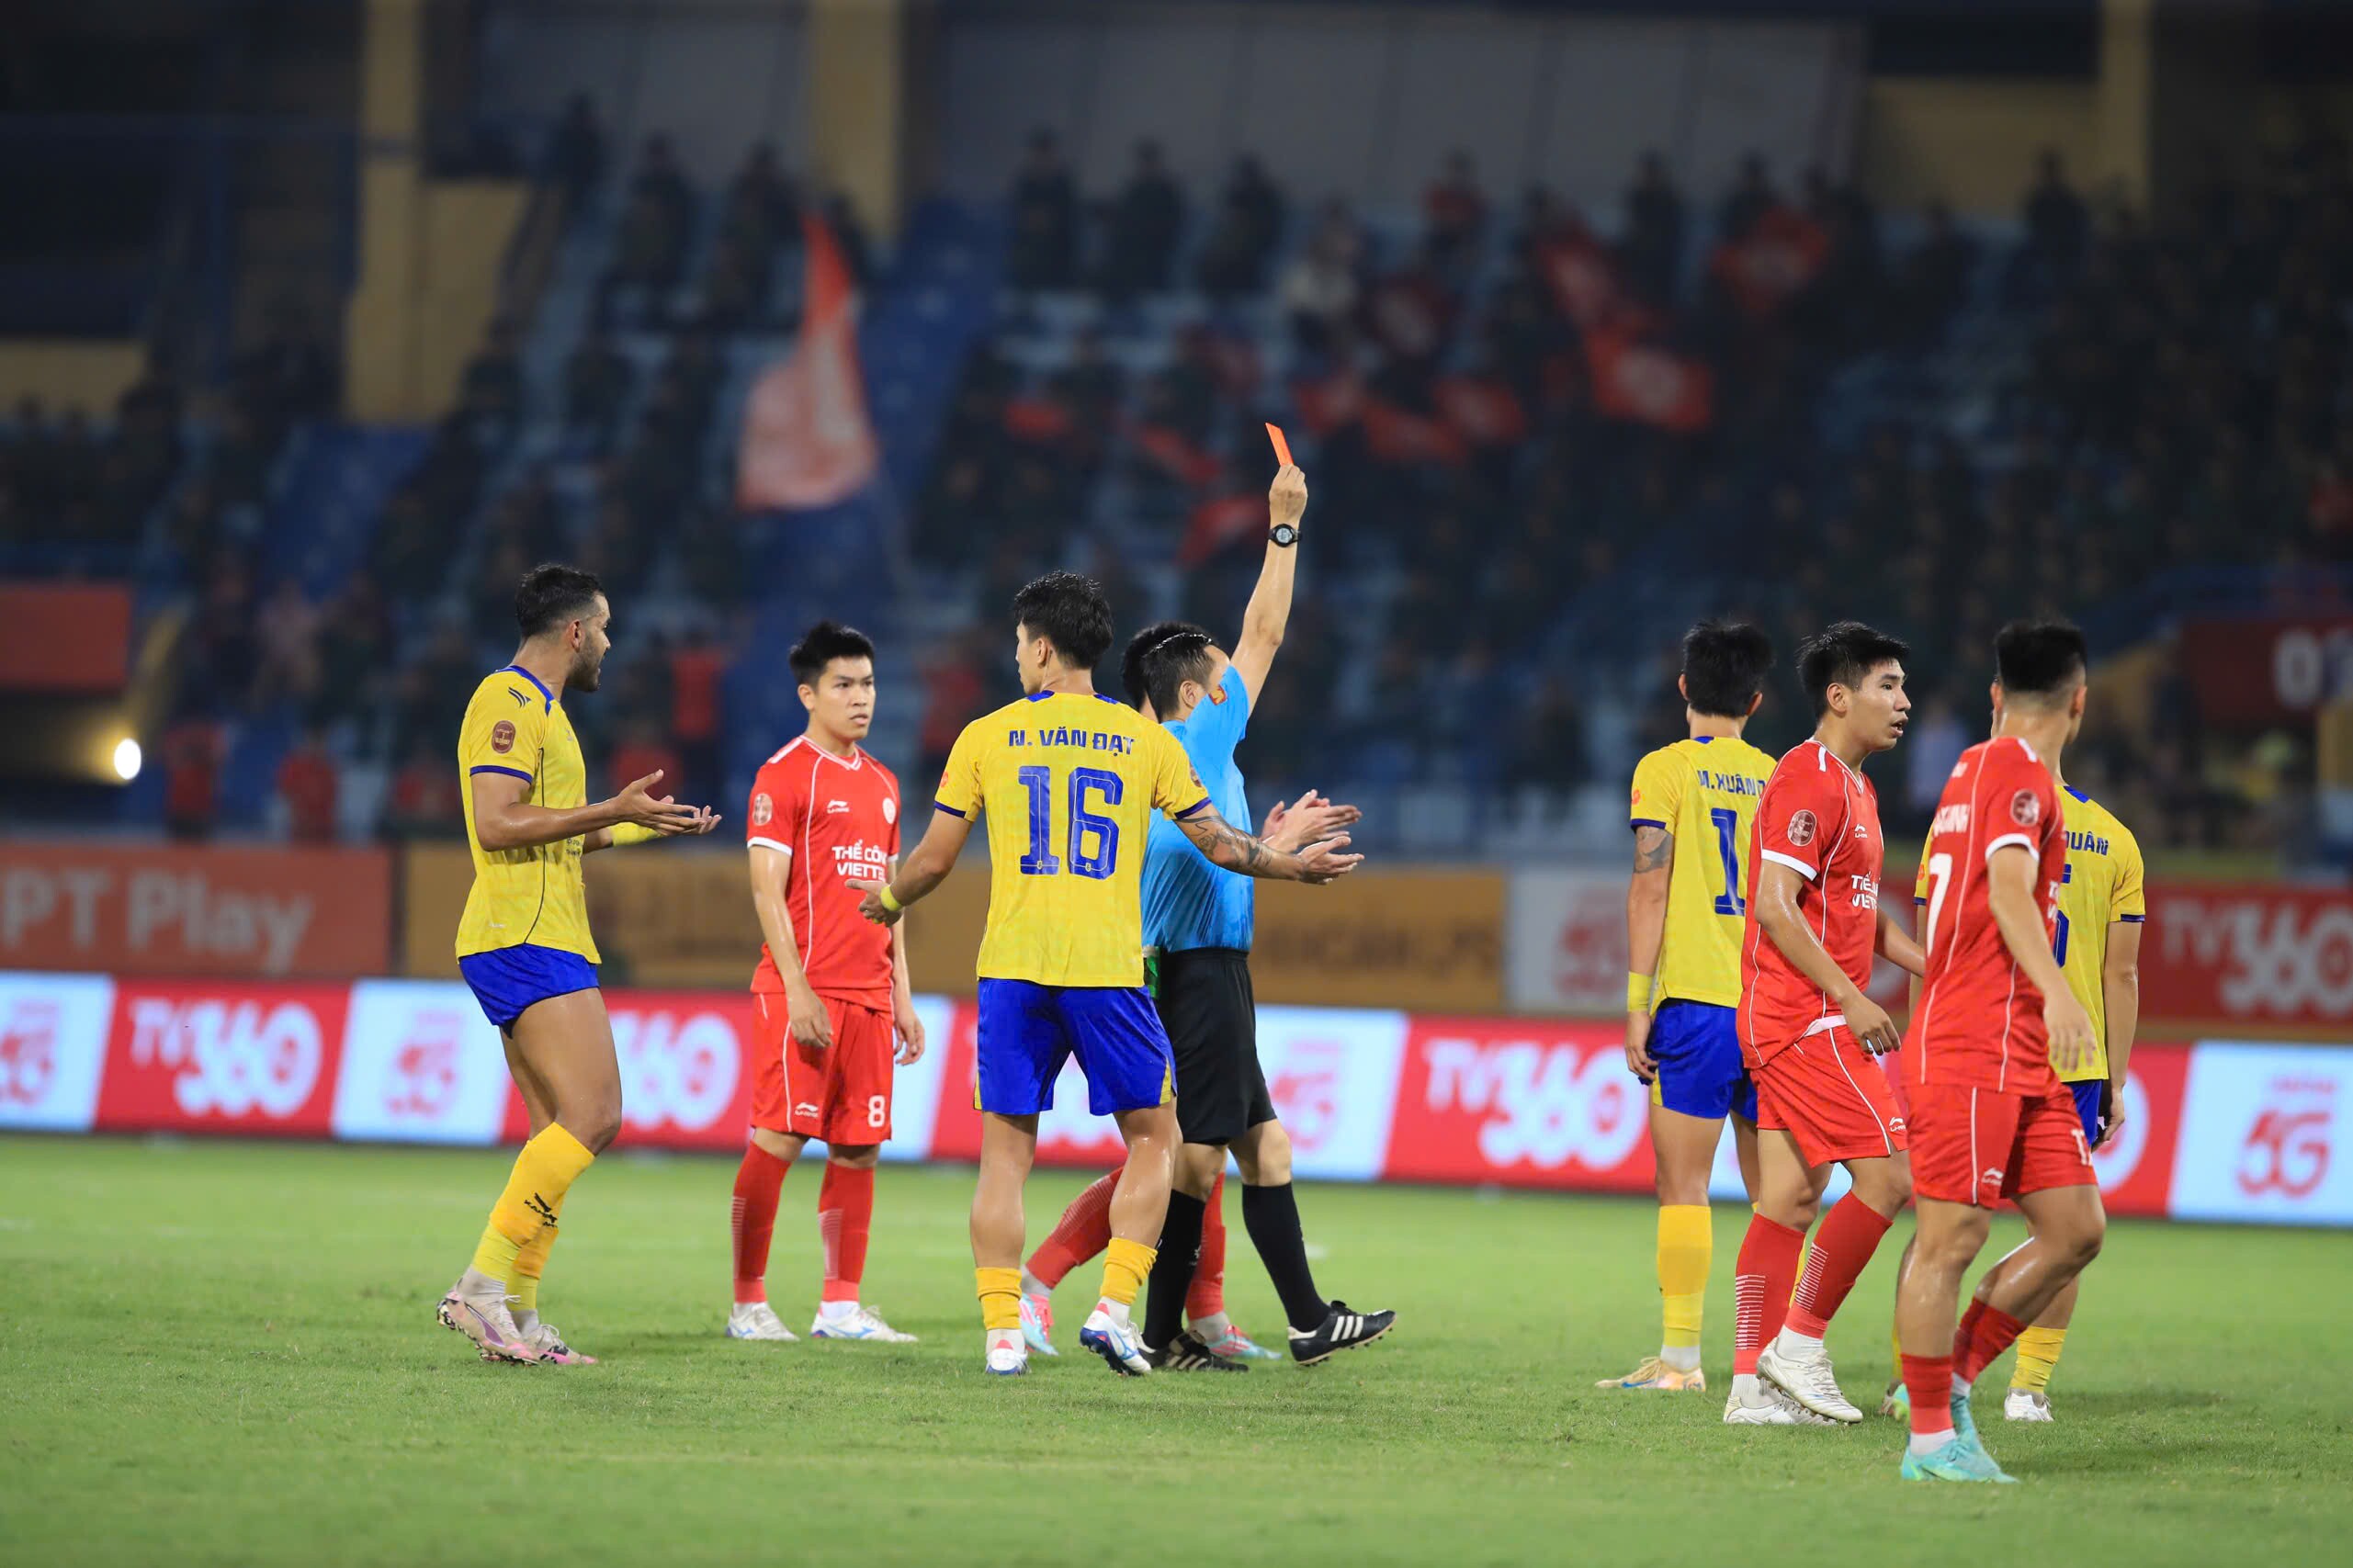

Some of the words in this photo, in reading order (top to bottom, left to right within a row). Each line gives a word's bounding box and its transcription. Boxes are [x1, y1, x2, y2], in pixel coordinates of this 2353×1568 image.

[1009, 729, 1033, 746] N.
[1039, 726, 1087, 747] VĂN
[1092, 732, 1135, 756] ĐẠT
[831, 839, 863, 861] THỂ
[1018, 765, 1124, 880] 16
[1710, 807, 1745, 916] 1
[127, 867, 314, 976] Play
[2161, 897, 2353, 1018] TV360
[867, 1094, 886, 1128] 8
[2235, 1107, 2331, 1200] 5G
